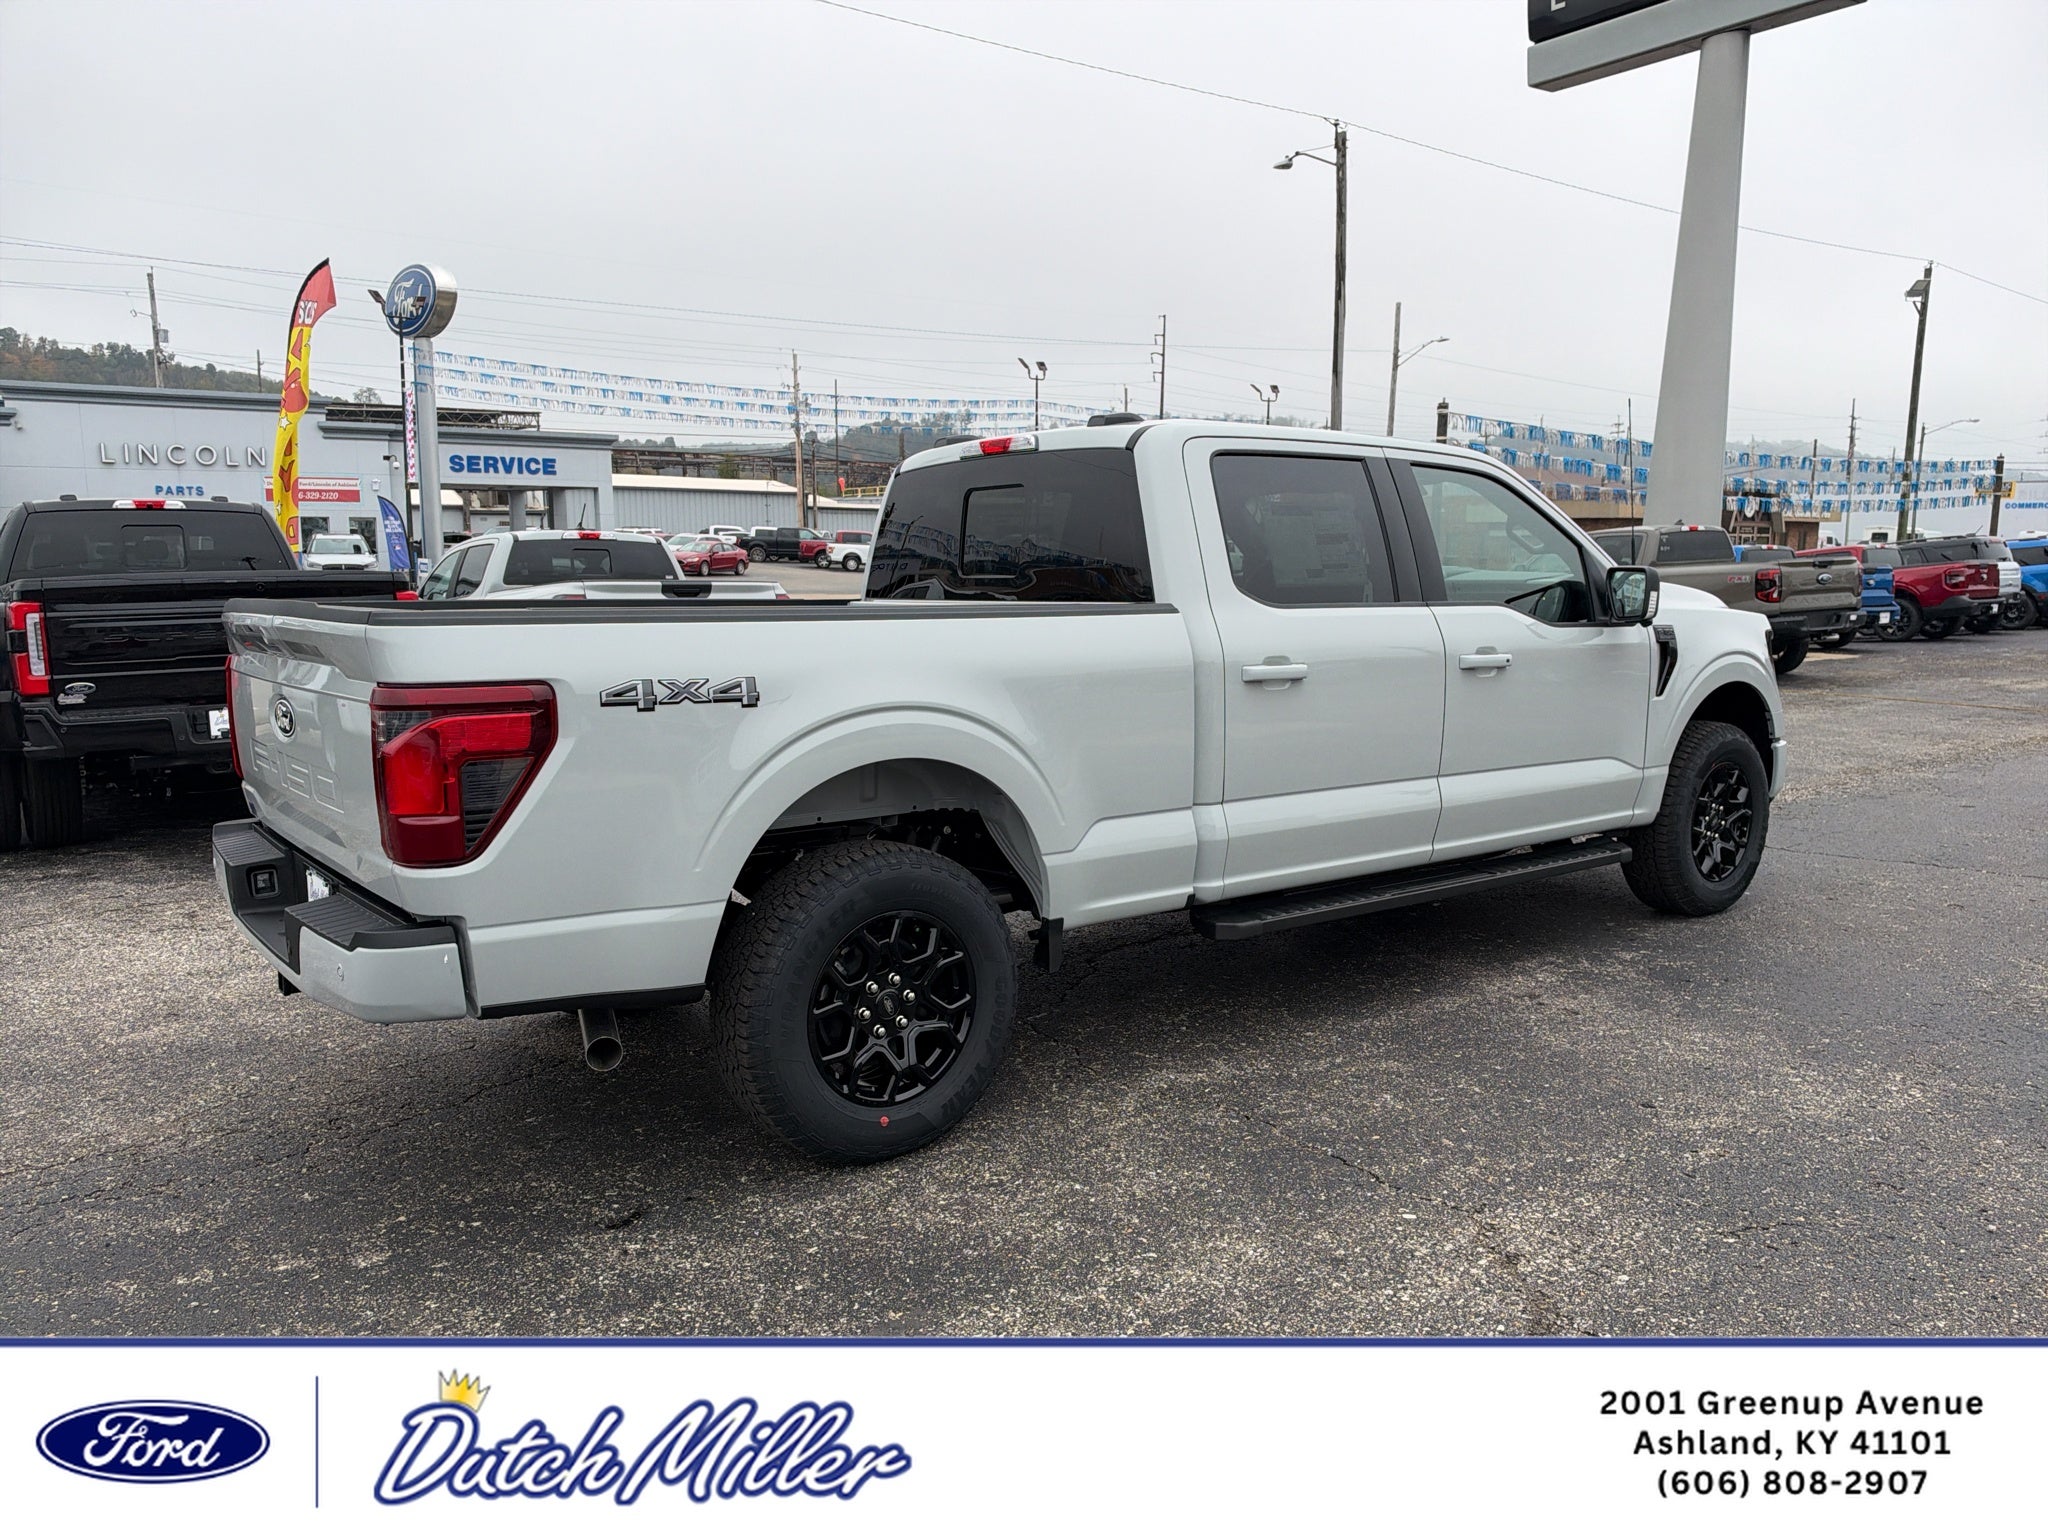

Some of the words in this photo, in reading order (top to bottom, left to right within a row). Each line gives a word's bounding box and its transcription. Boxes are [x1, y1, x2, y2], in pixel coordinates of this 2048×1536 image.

[99, 442, 266, 467] LINCOLN
[449, 454, 557, 476] SERVICE
[155, 485, 205, 496] PARTS
[298, 491, 339, 500] 6-329-2120
